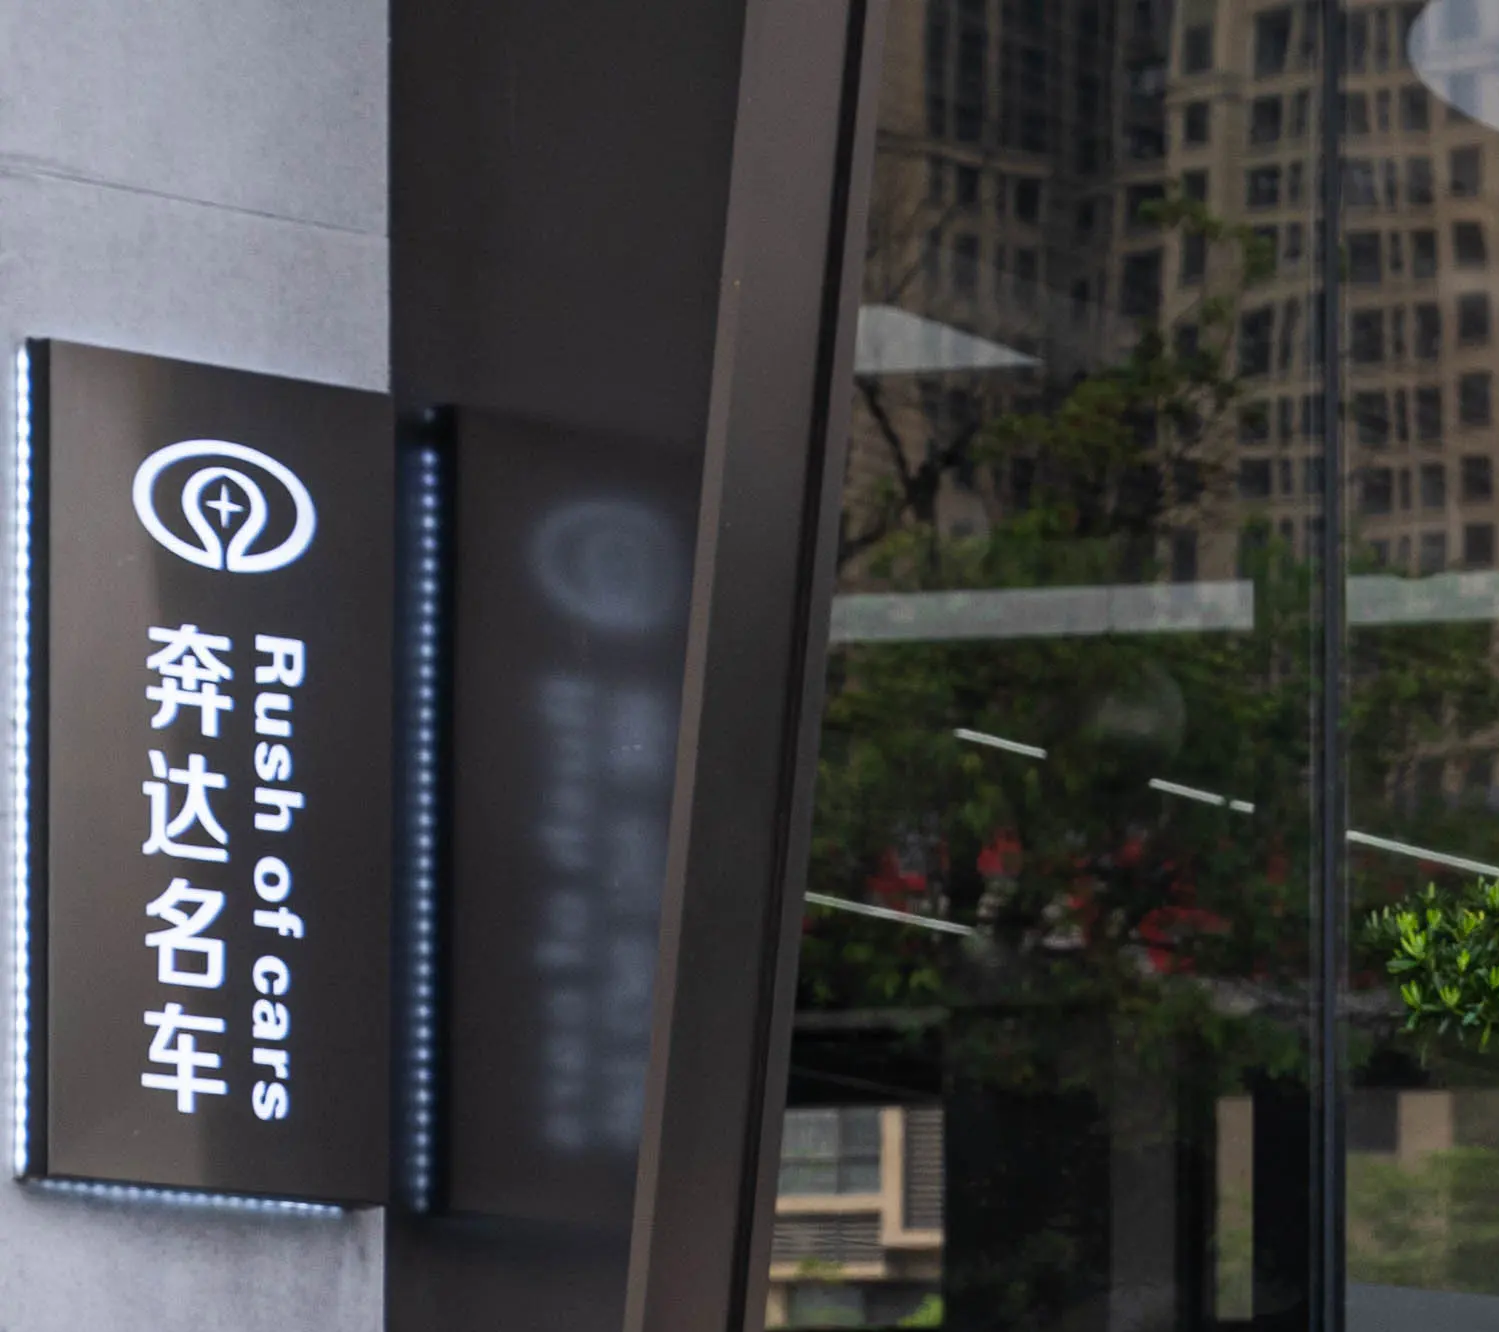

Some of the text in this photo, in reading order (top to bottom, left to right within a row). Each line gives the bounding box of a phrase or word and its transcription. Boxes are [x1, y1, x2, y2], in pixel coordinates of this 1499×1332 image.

[142, 624, 232, 1113] 奔达名车
[253, 635, 303, 1119] Rush of cars
